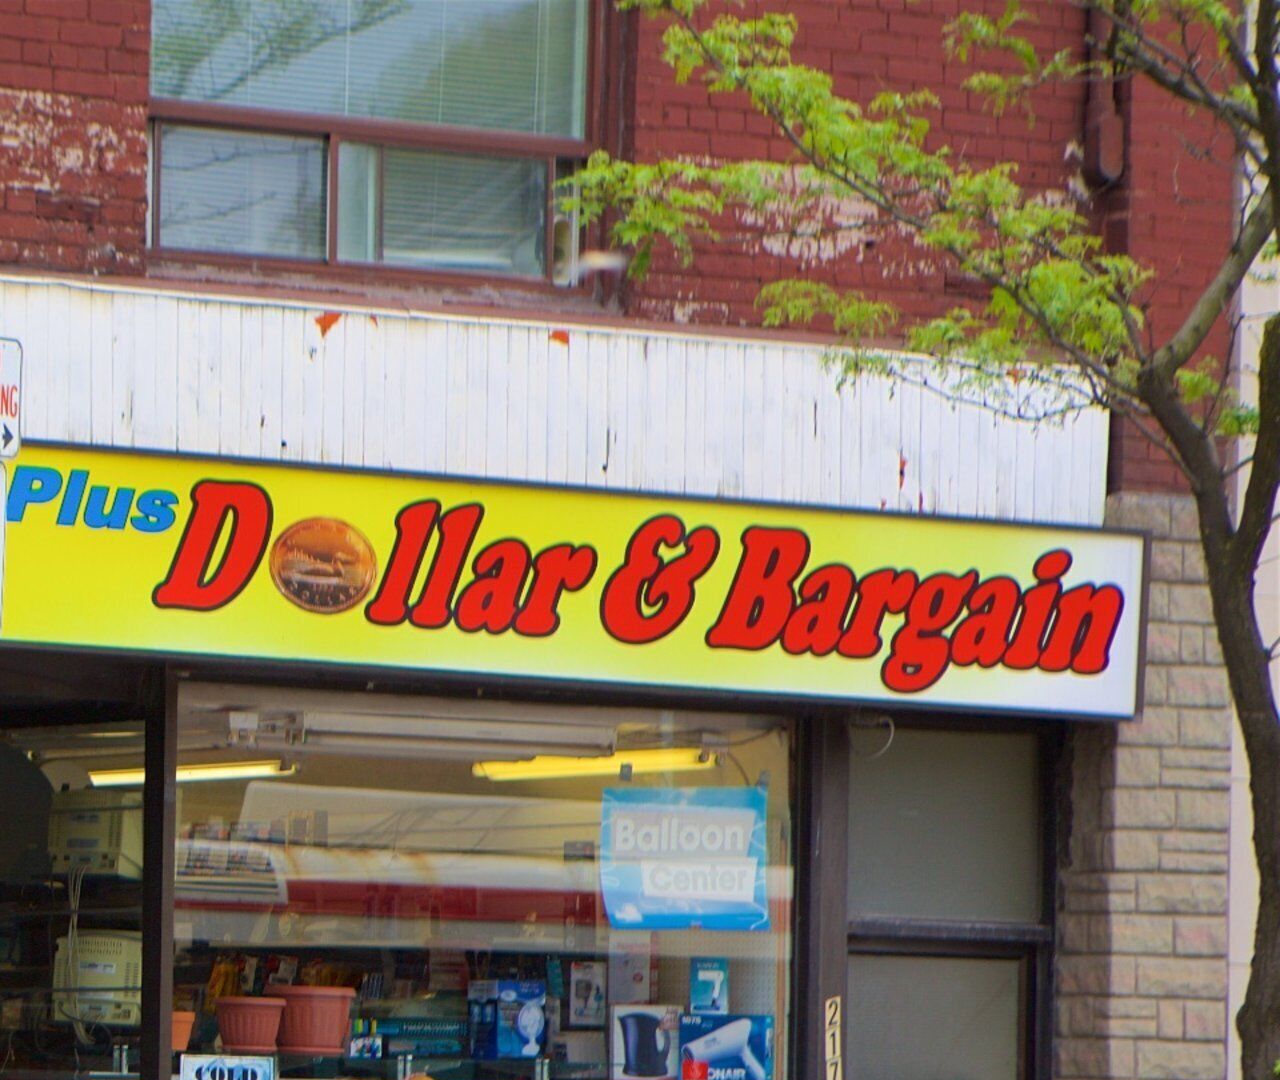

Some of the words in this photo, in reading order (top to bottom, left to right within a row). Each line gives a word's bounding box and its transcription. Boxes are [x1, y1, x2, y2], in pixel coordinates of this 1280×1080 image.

[6, 465, 180, 533] Plus
[600, 513, 720, 645] &
[706, 525, 1125, 693] Bargain
[615, 815, 745, 852] Balloon
[648, 862, 748, 893] Center
